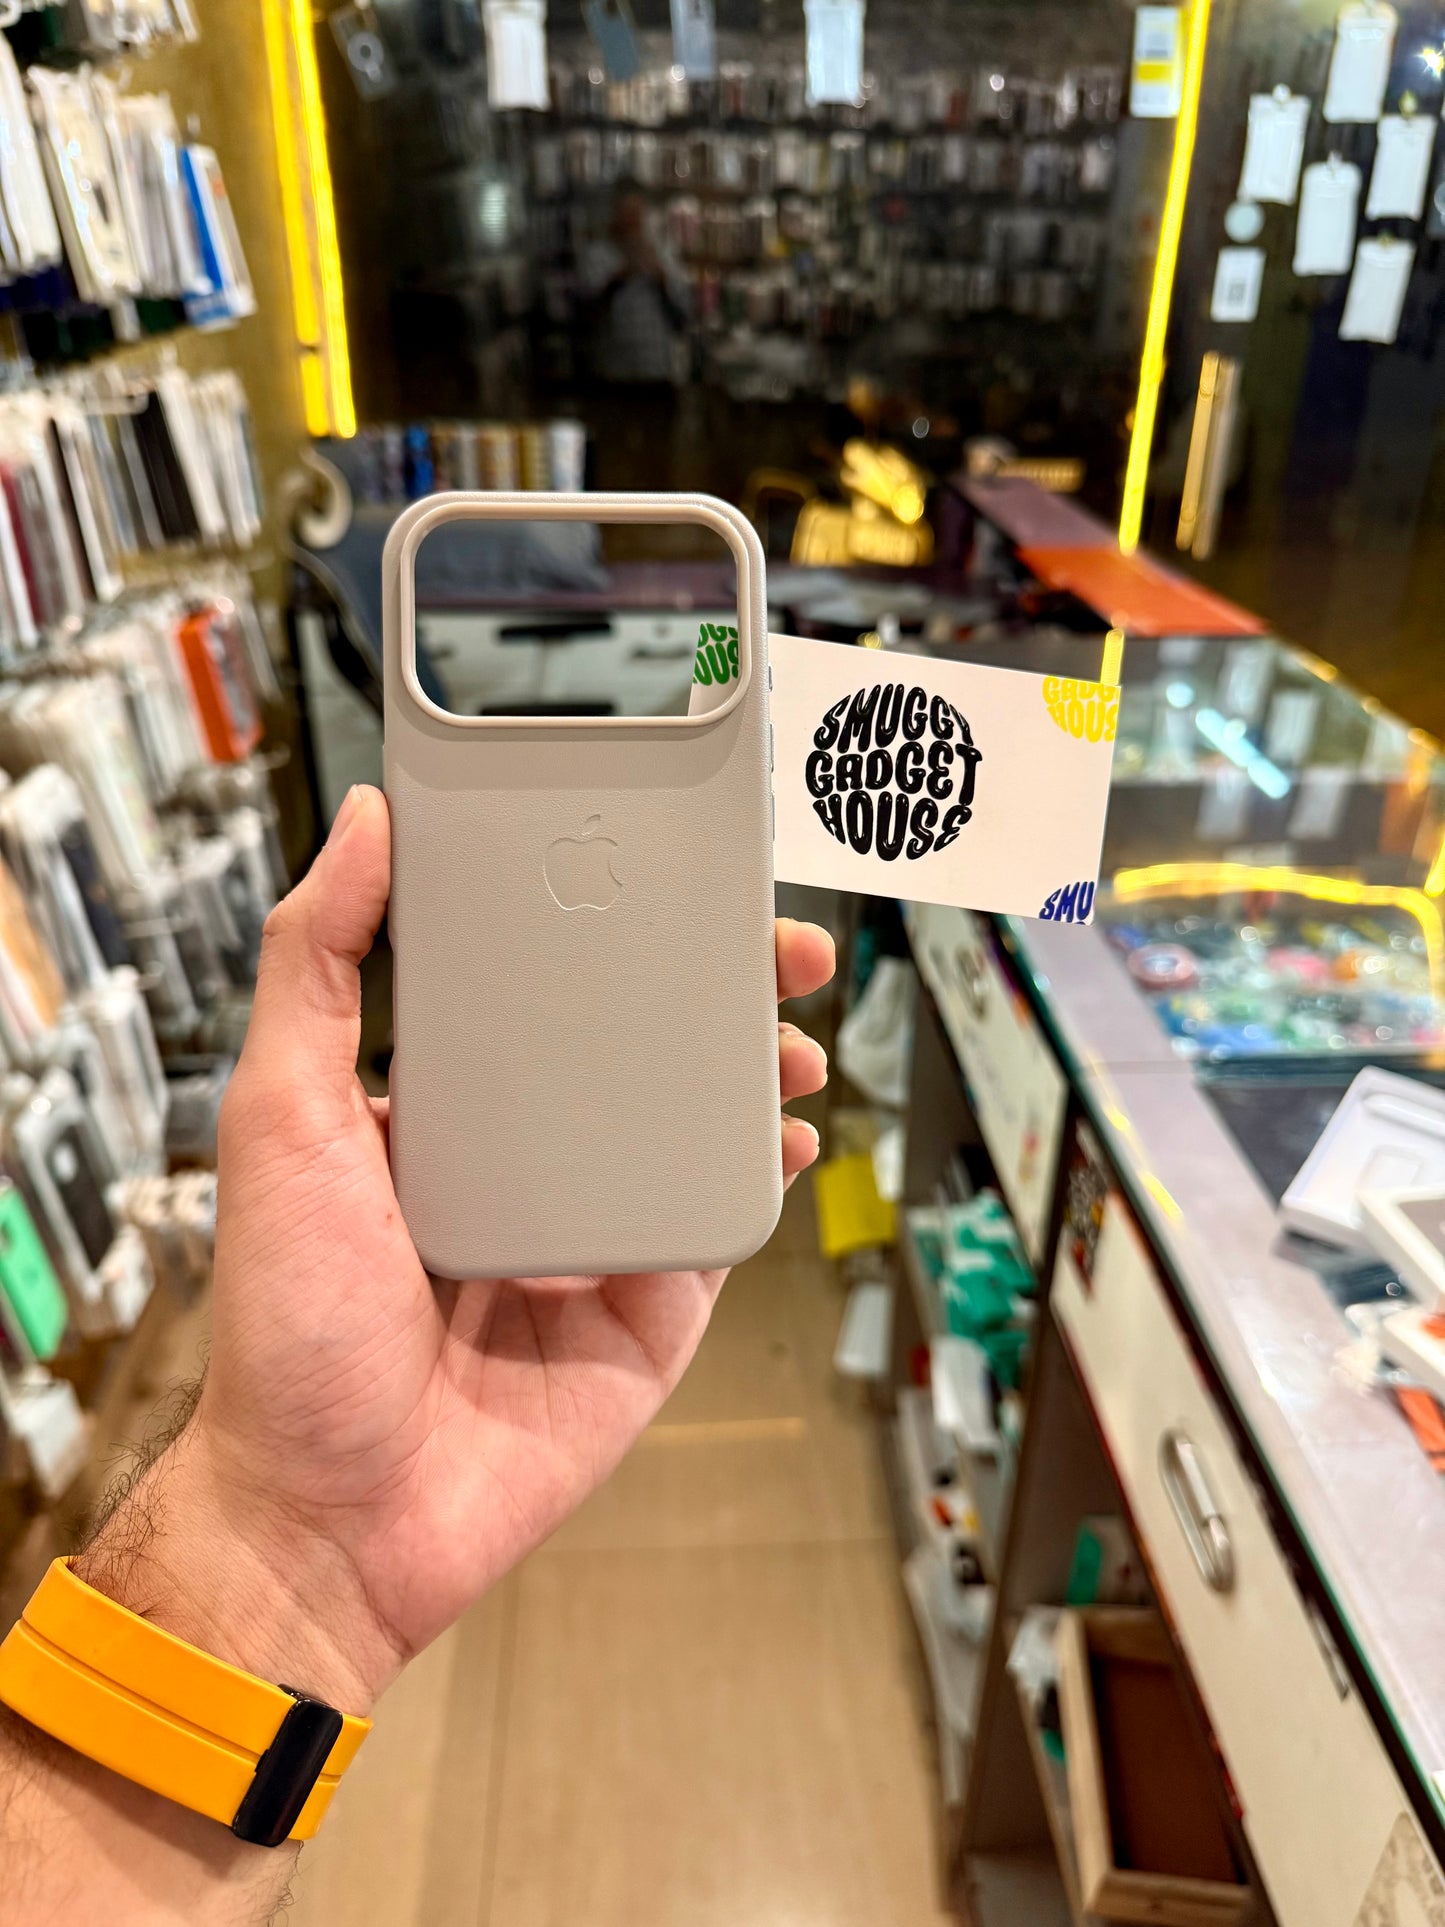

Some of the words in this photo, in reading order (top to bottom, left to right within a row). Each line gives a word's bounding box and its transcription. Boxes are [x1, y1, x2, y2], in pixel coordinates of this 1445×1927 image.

[813, 683, 974, 754] SMUGGY
[805, 740, 983, 806] GADGET
[812, 790, 973, 862] HOUSE
